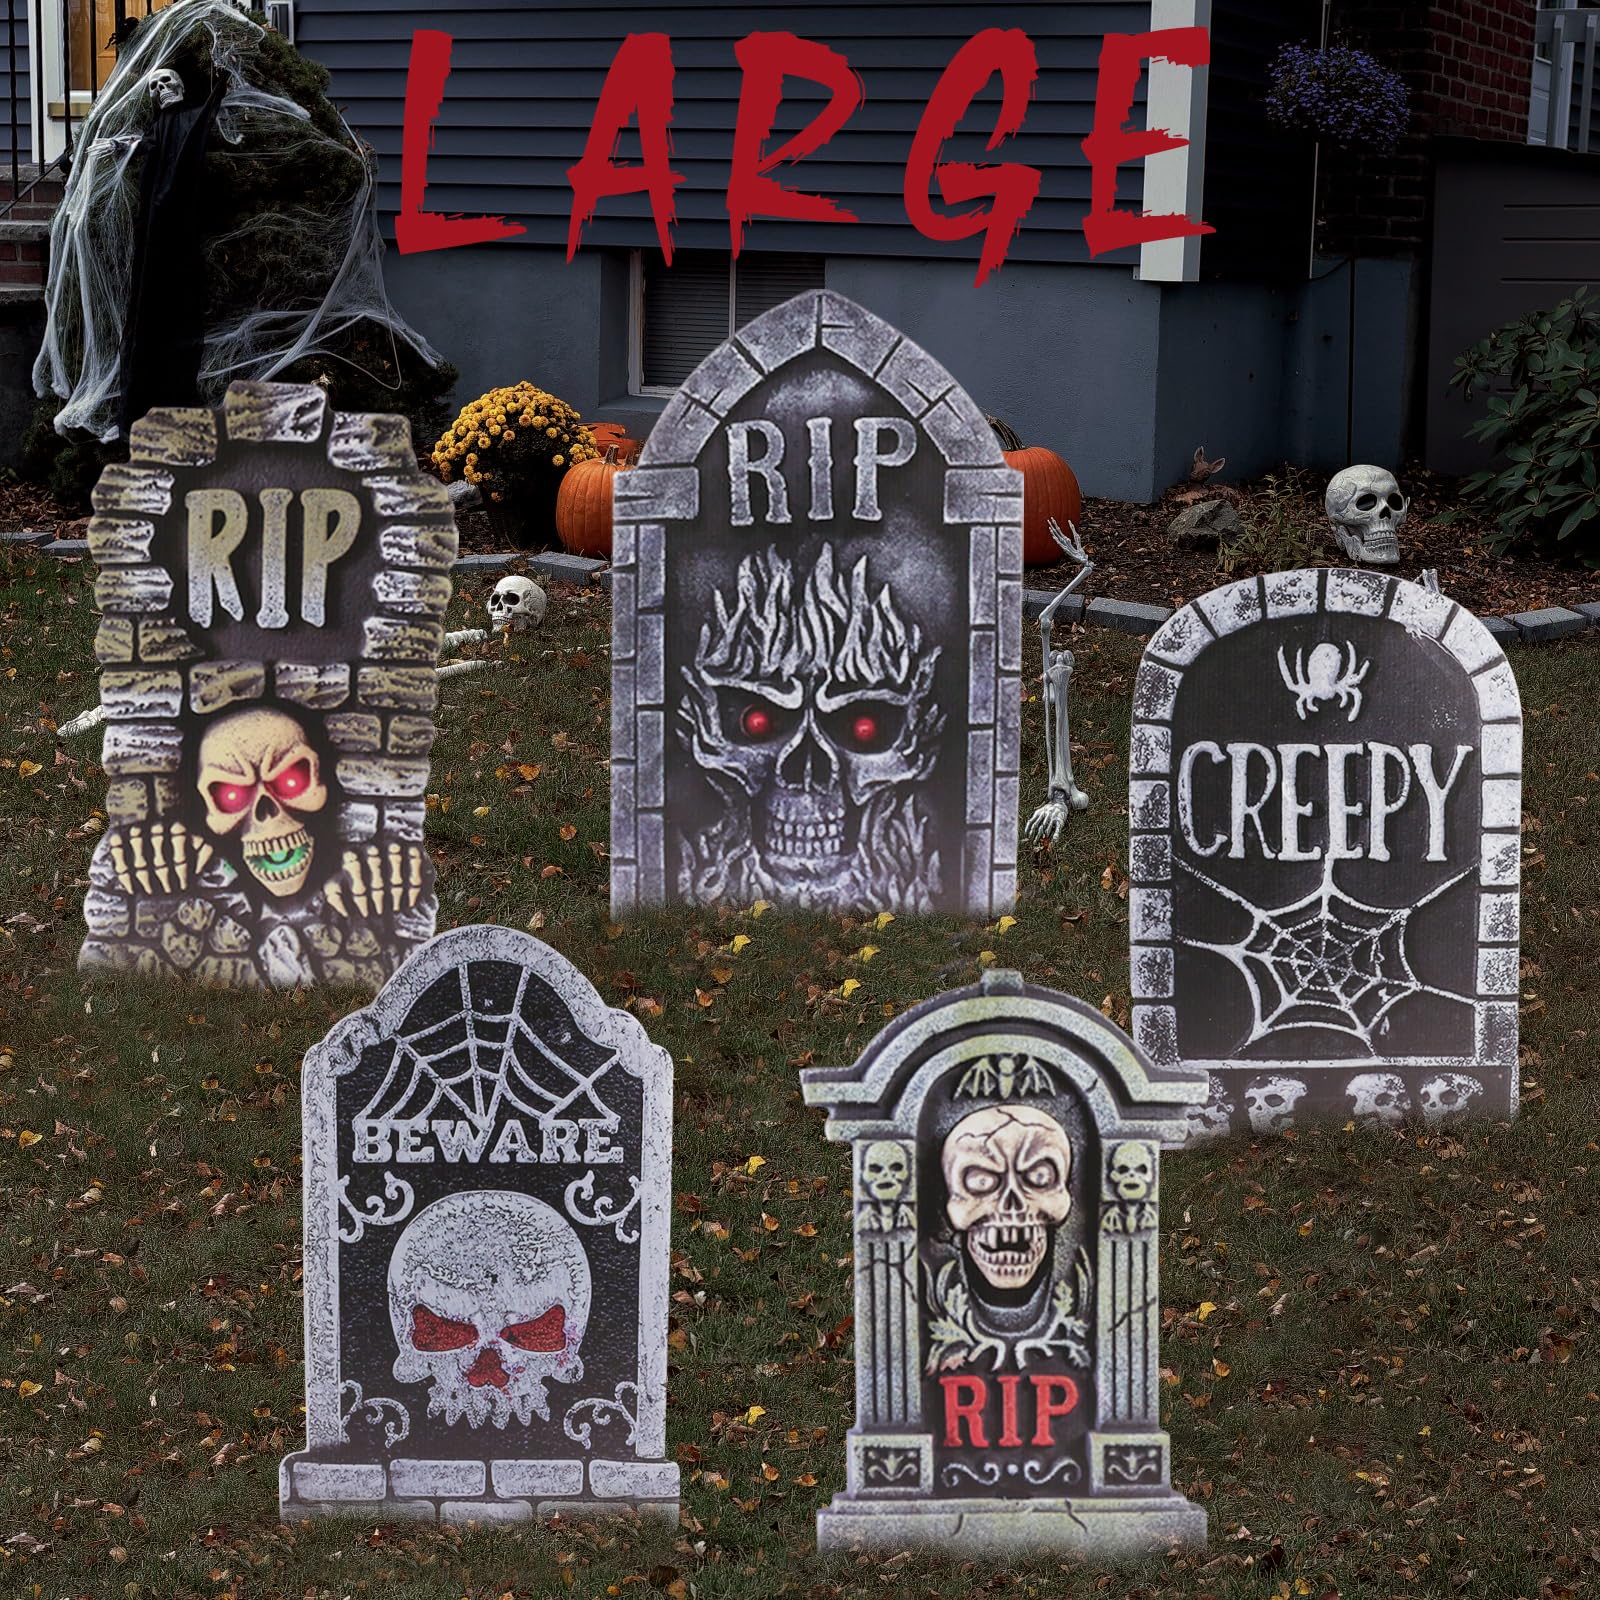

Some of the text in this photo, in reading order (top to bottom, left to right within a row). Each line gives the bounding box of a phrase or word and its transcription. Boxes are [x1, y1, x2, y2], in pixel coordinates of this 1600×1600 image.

[726, 416, 918, 527] RIP
[183, 487, 363, 630] RIP
[1178, 740, 1474, 863] CREEPY
[351, 1115, 625, 1165] BEWARE
[938, 1372, 1080, 1449] RIP
